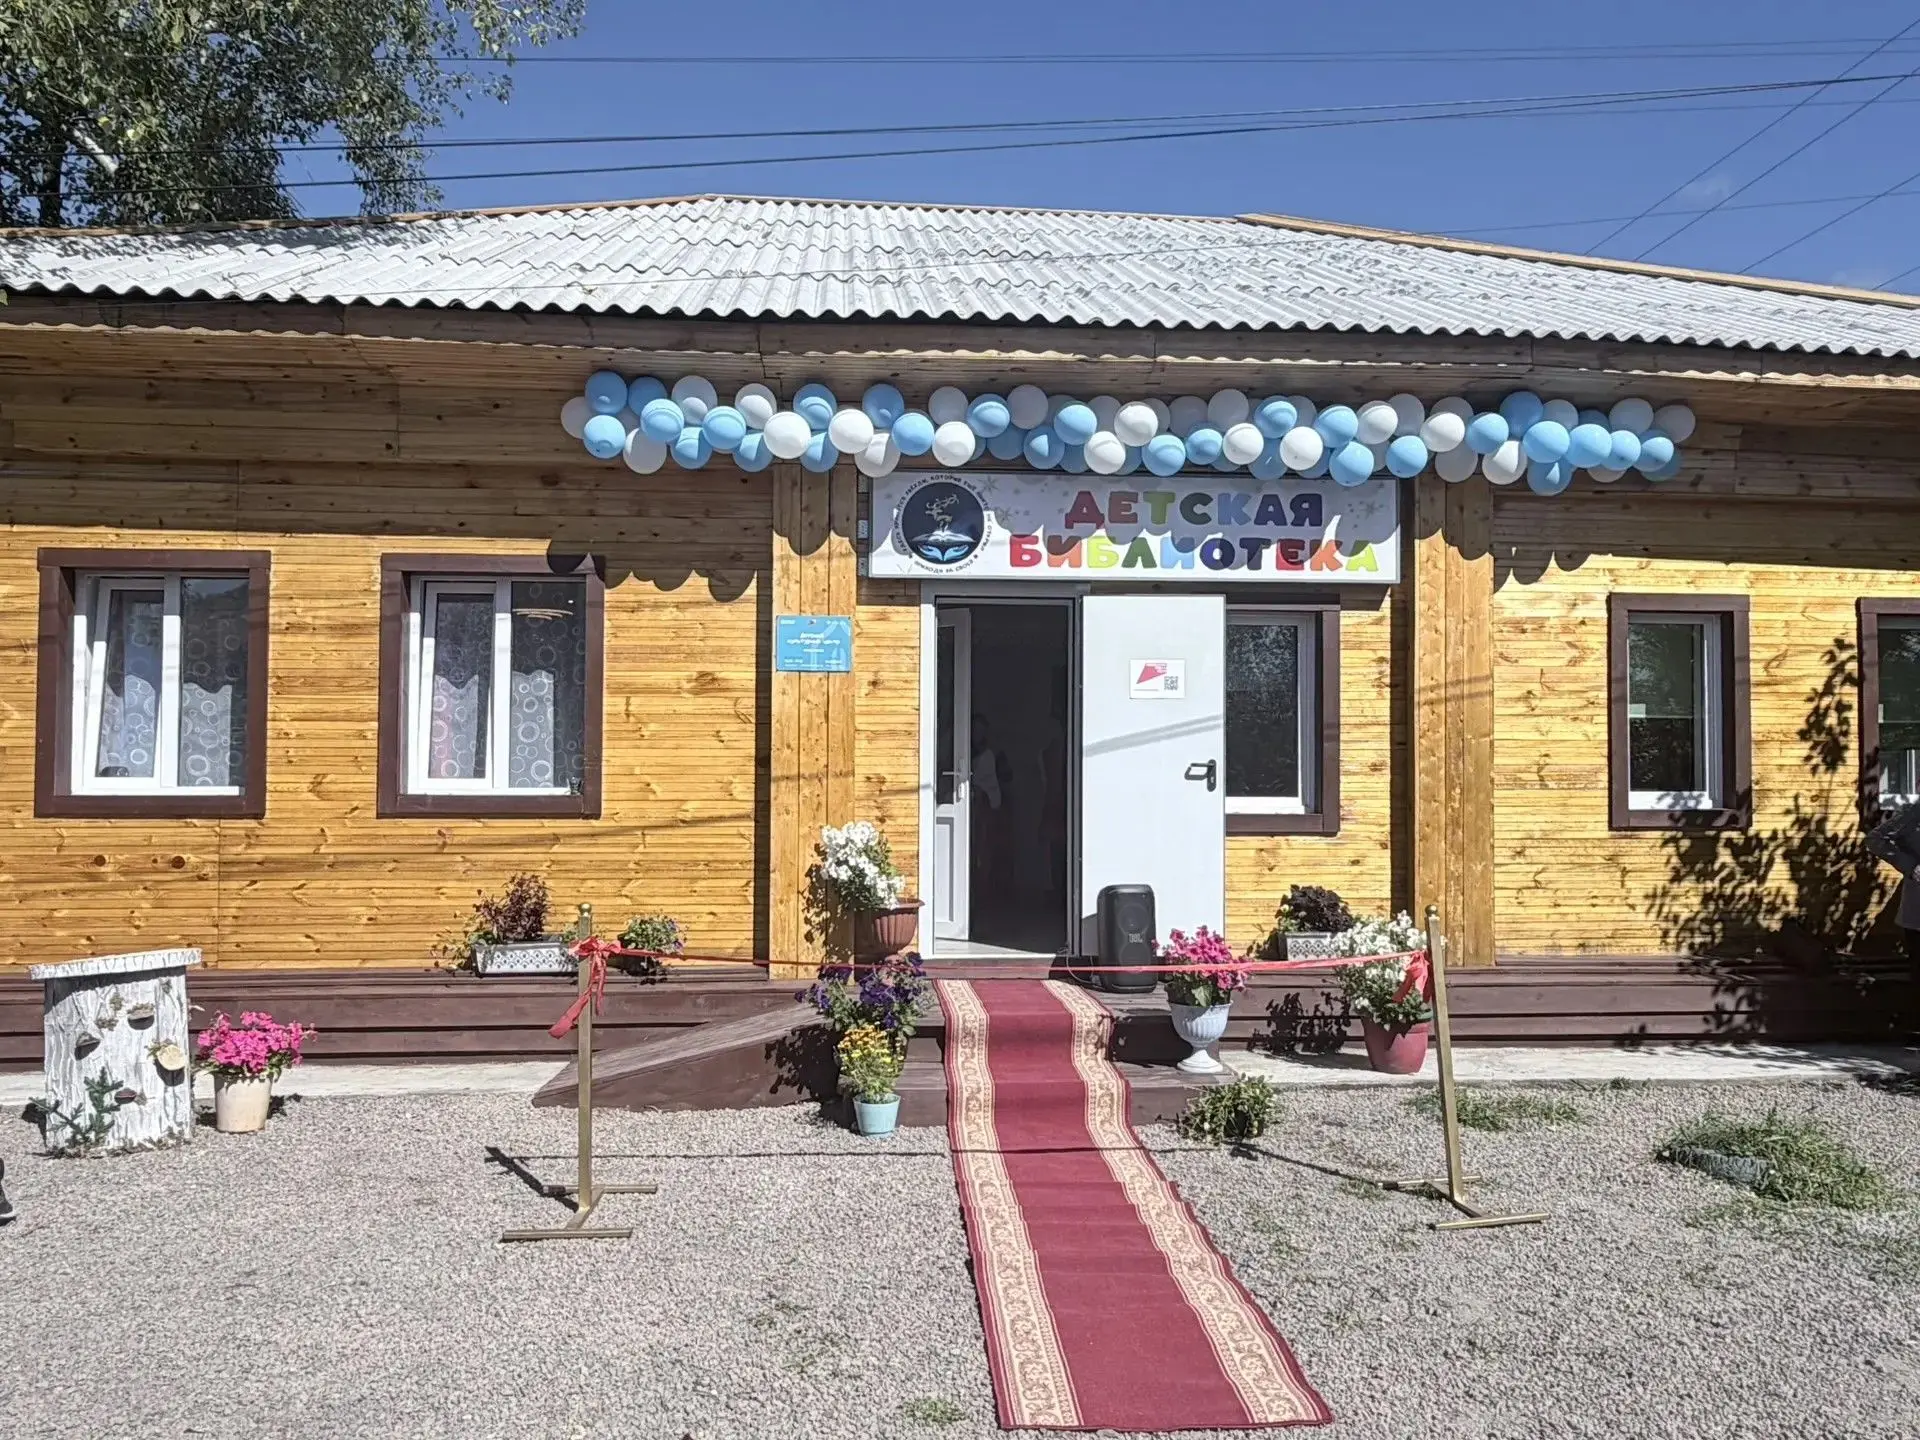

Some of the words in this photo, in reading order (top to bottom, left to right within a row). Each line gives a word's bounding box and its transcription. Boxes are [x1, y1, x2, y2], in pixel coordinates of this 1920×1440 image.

[1064, 490, 1323, 529] ДЕТСКАЯ
[1009, 534, 1379, 572] БИБЛИОТЕКА
[1129, 933, 1143, 943] JBL
